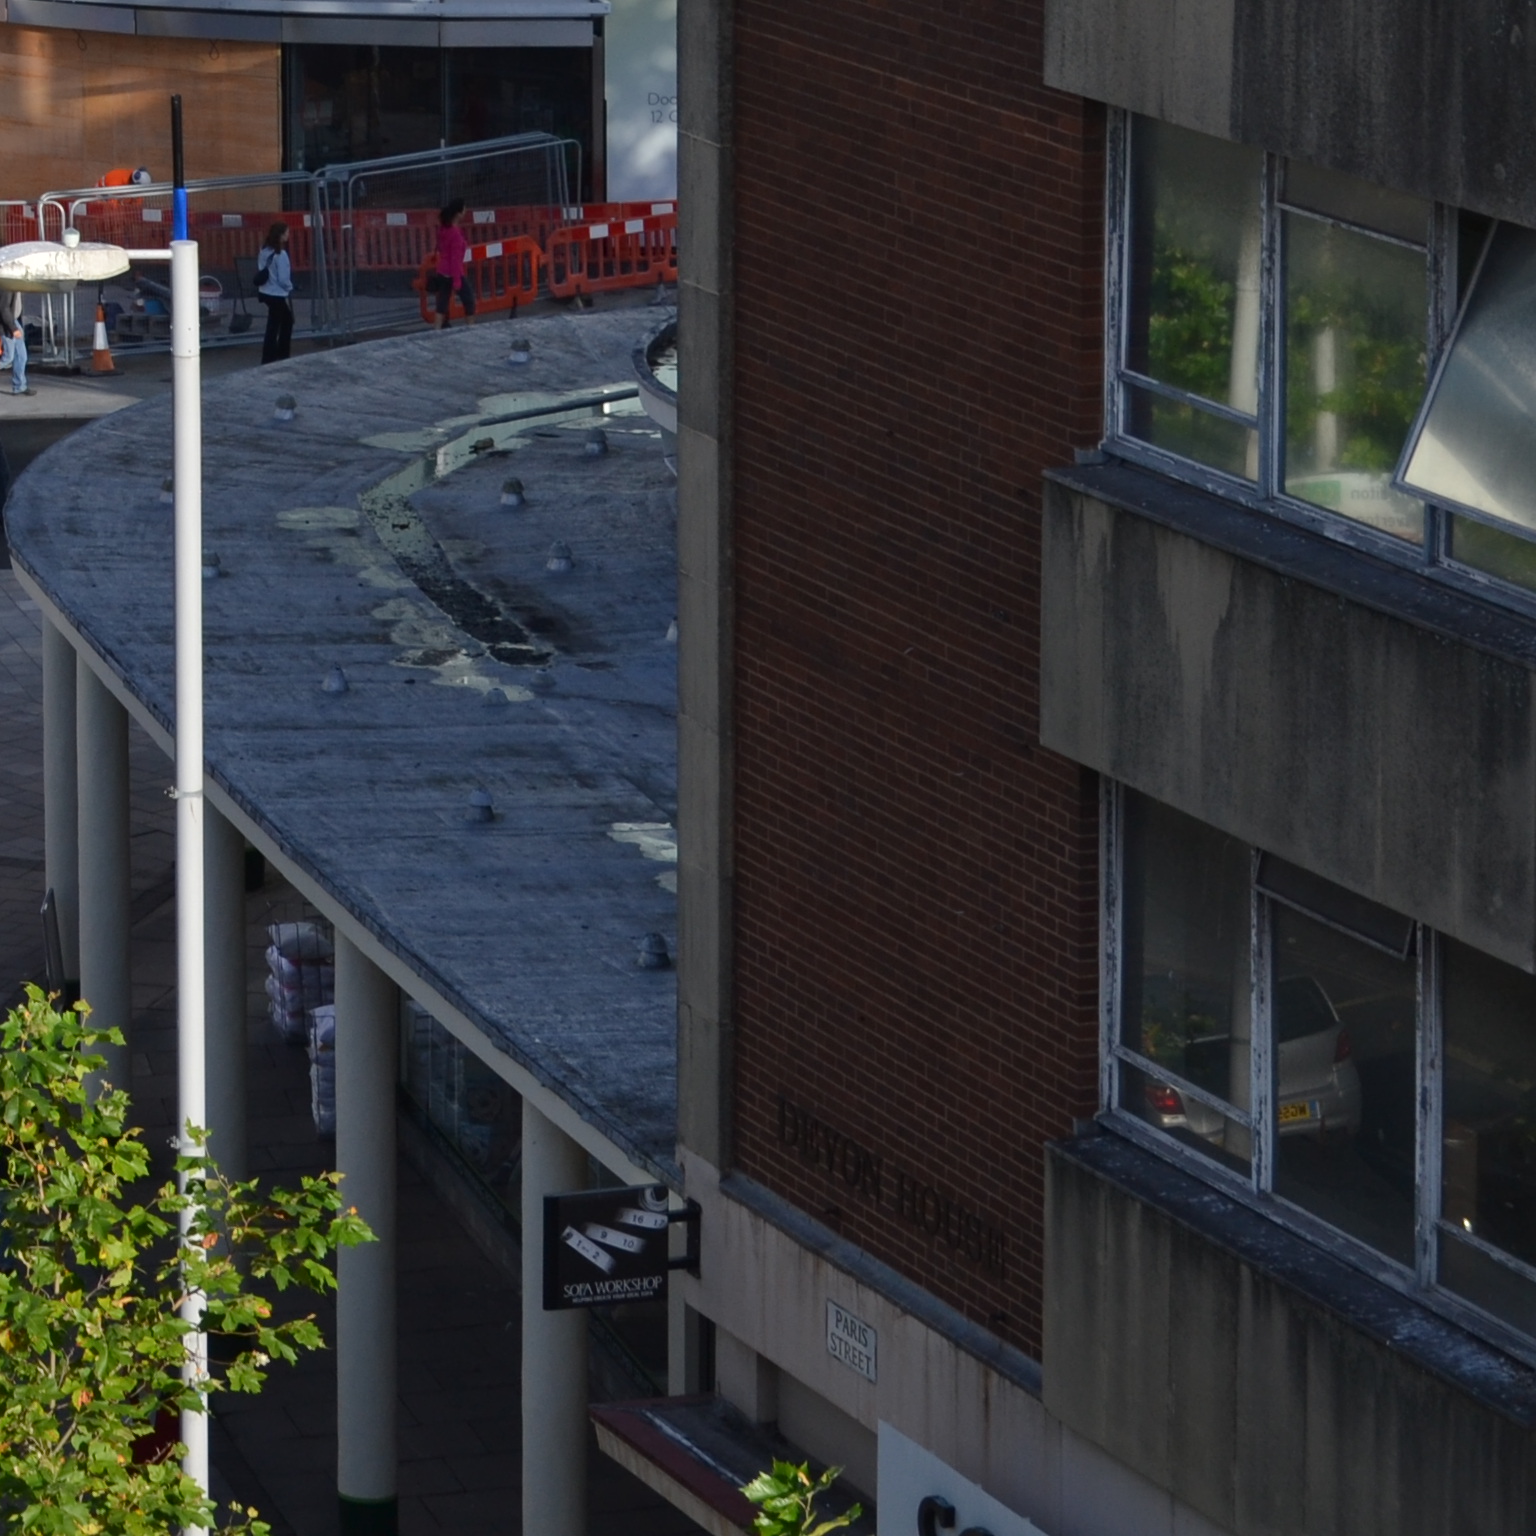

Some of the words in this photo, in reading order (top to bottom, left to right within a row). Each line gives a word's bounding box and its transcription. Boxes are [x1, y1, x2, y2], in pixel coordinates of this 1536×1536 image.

[777, 1092, 883, 1205] DEVON
[894, 1166, 1006, 1282] HOUSE
[563, 1283, 593, 1298] SOFA
[595, 1276, 663, 1295] WORKSHOP
[835, 1309, 868, 1347] PARIS
[831, 1332, 872, 1375] STREET
